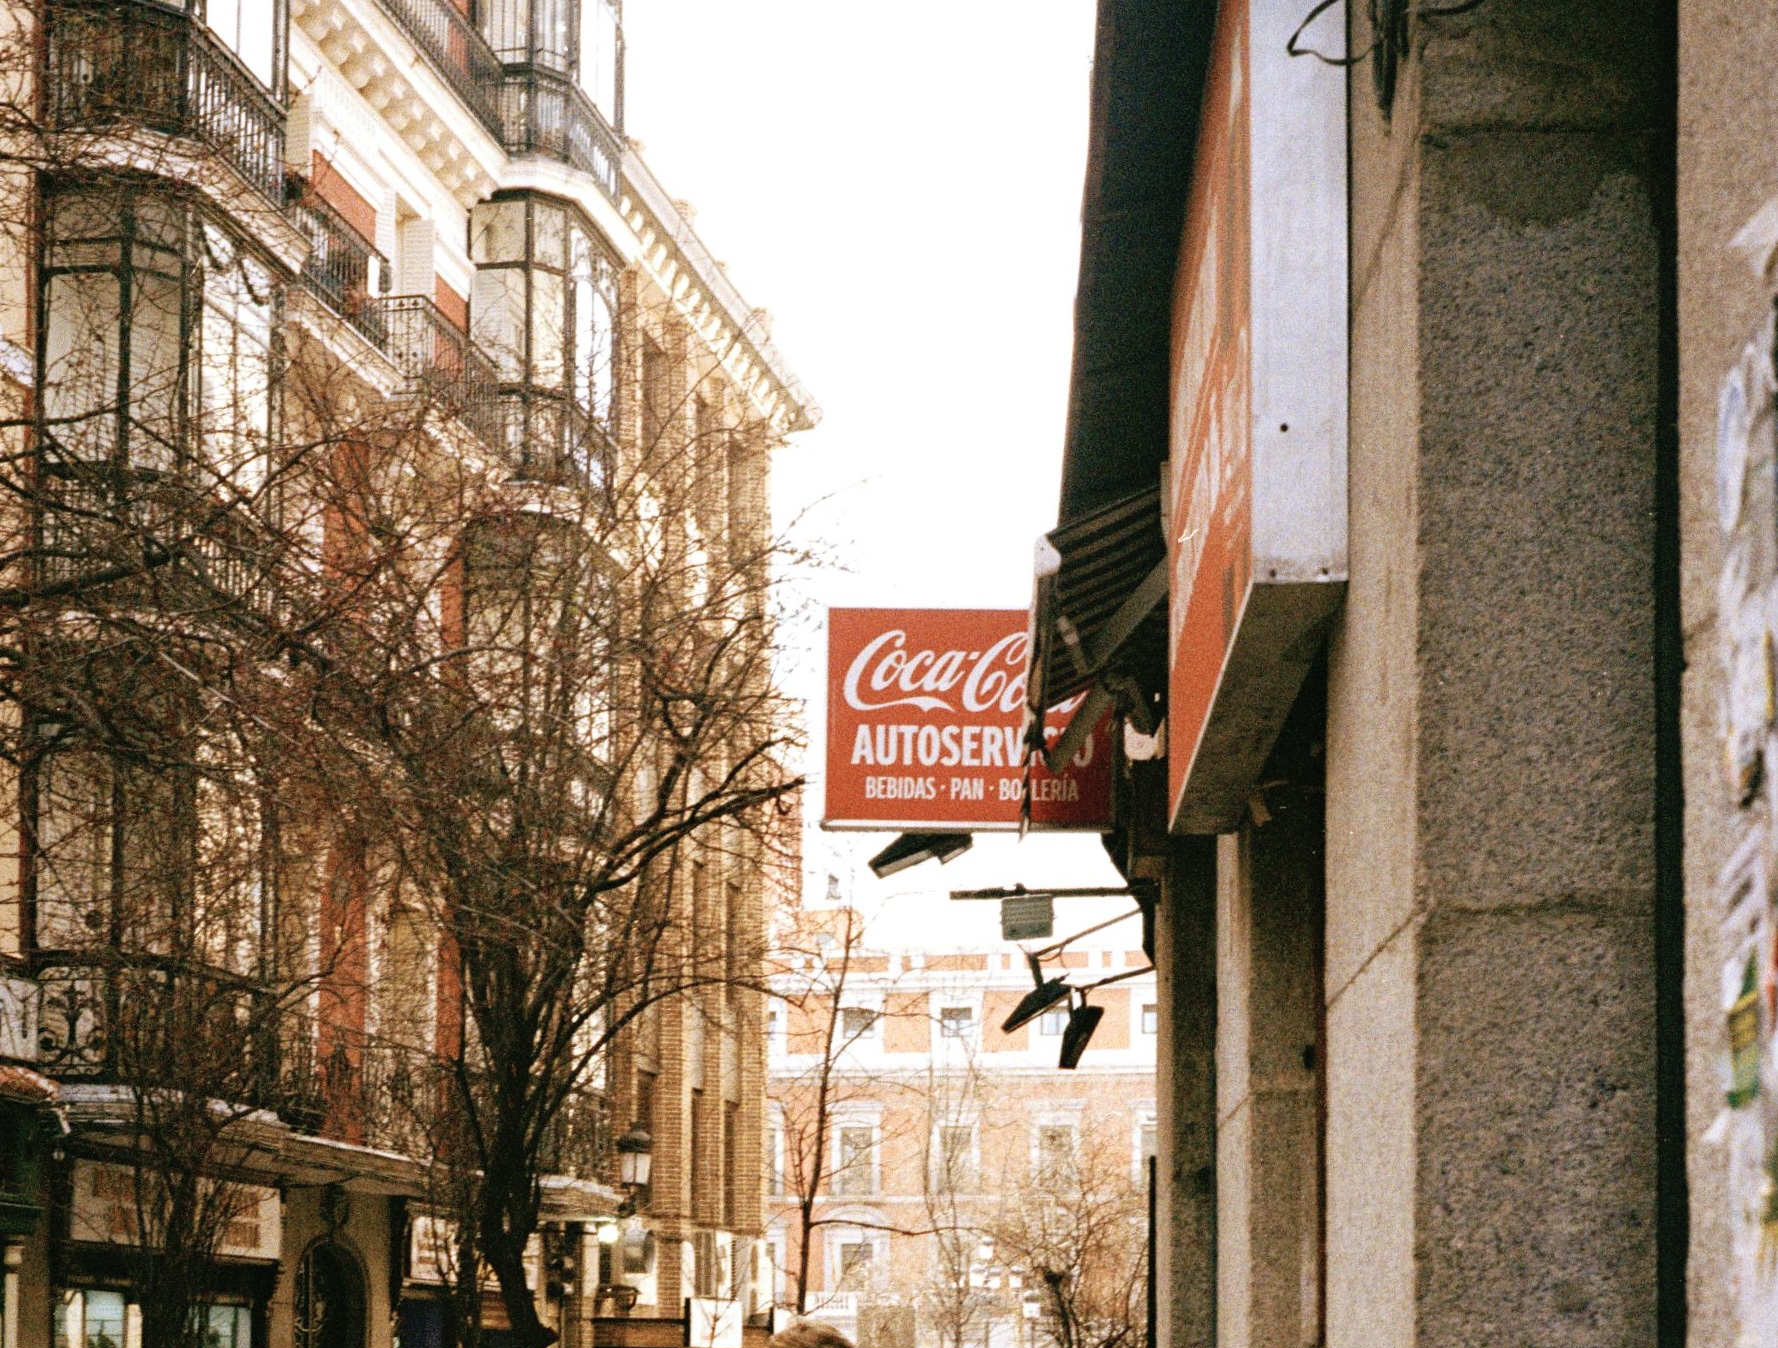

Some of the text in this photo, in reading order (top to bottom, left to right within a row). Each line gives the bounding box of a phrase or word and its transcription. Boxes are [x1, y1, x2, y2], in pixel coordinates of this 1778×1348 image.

[843, 629, 1090, 714] Coca-Co
[850, 723, 1095, 768] AUTOSERVO
[864, 774, 1079, 802] BEBIDAS PAN BOLERÍA
